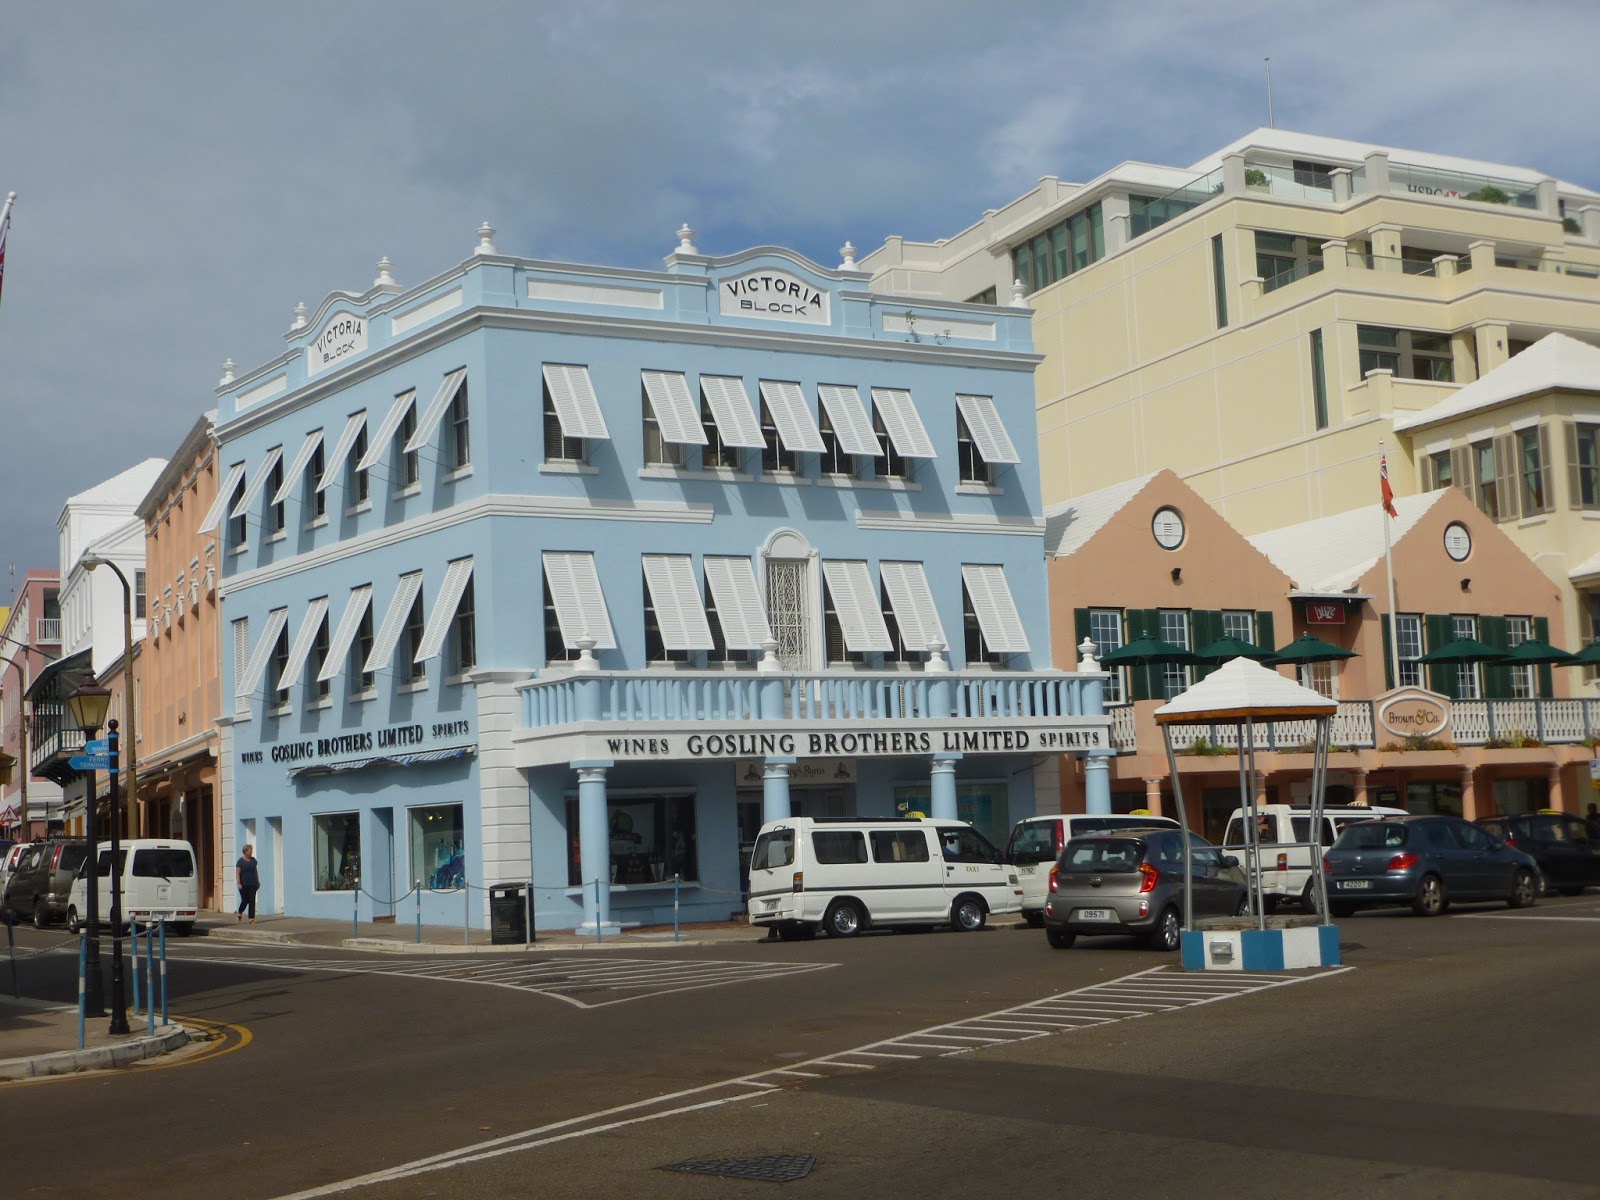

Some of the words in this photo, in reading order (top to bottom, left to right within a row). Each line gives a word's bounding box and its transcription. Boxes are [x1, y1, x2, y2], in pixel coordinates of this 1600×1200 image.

[727, 277, 821, 308] VICTORIA
[740, 300, 807, 316] BLOCK
[317, 320, 362, 353] VICTORIA
[323, 340, 355, 363] BLOCK
[1389, 712, 1415, 724] Brown
[1426, 711, 1440, 723] Co.
[241, 751, 263, 764] WINES
[271, 741, 314, 763] GOSLING
[317, 732, 373, 755] BROTHERS
[378, 725, 424, 748] LIMITED
[432, 720, 470, 738] SPIRITS
[607, 738, 670, 754] WINES
[687, 734, 796, 755] GOSLING
[808, 732, 931, 753] BROTHERS
[943, 730, 1029, 750] LIMITED
[1039, 731, 1099, 746] SPIRITS
[804, 765, 825, 775] Rums
[1084, 910, 1104, 918] 09571
